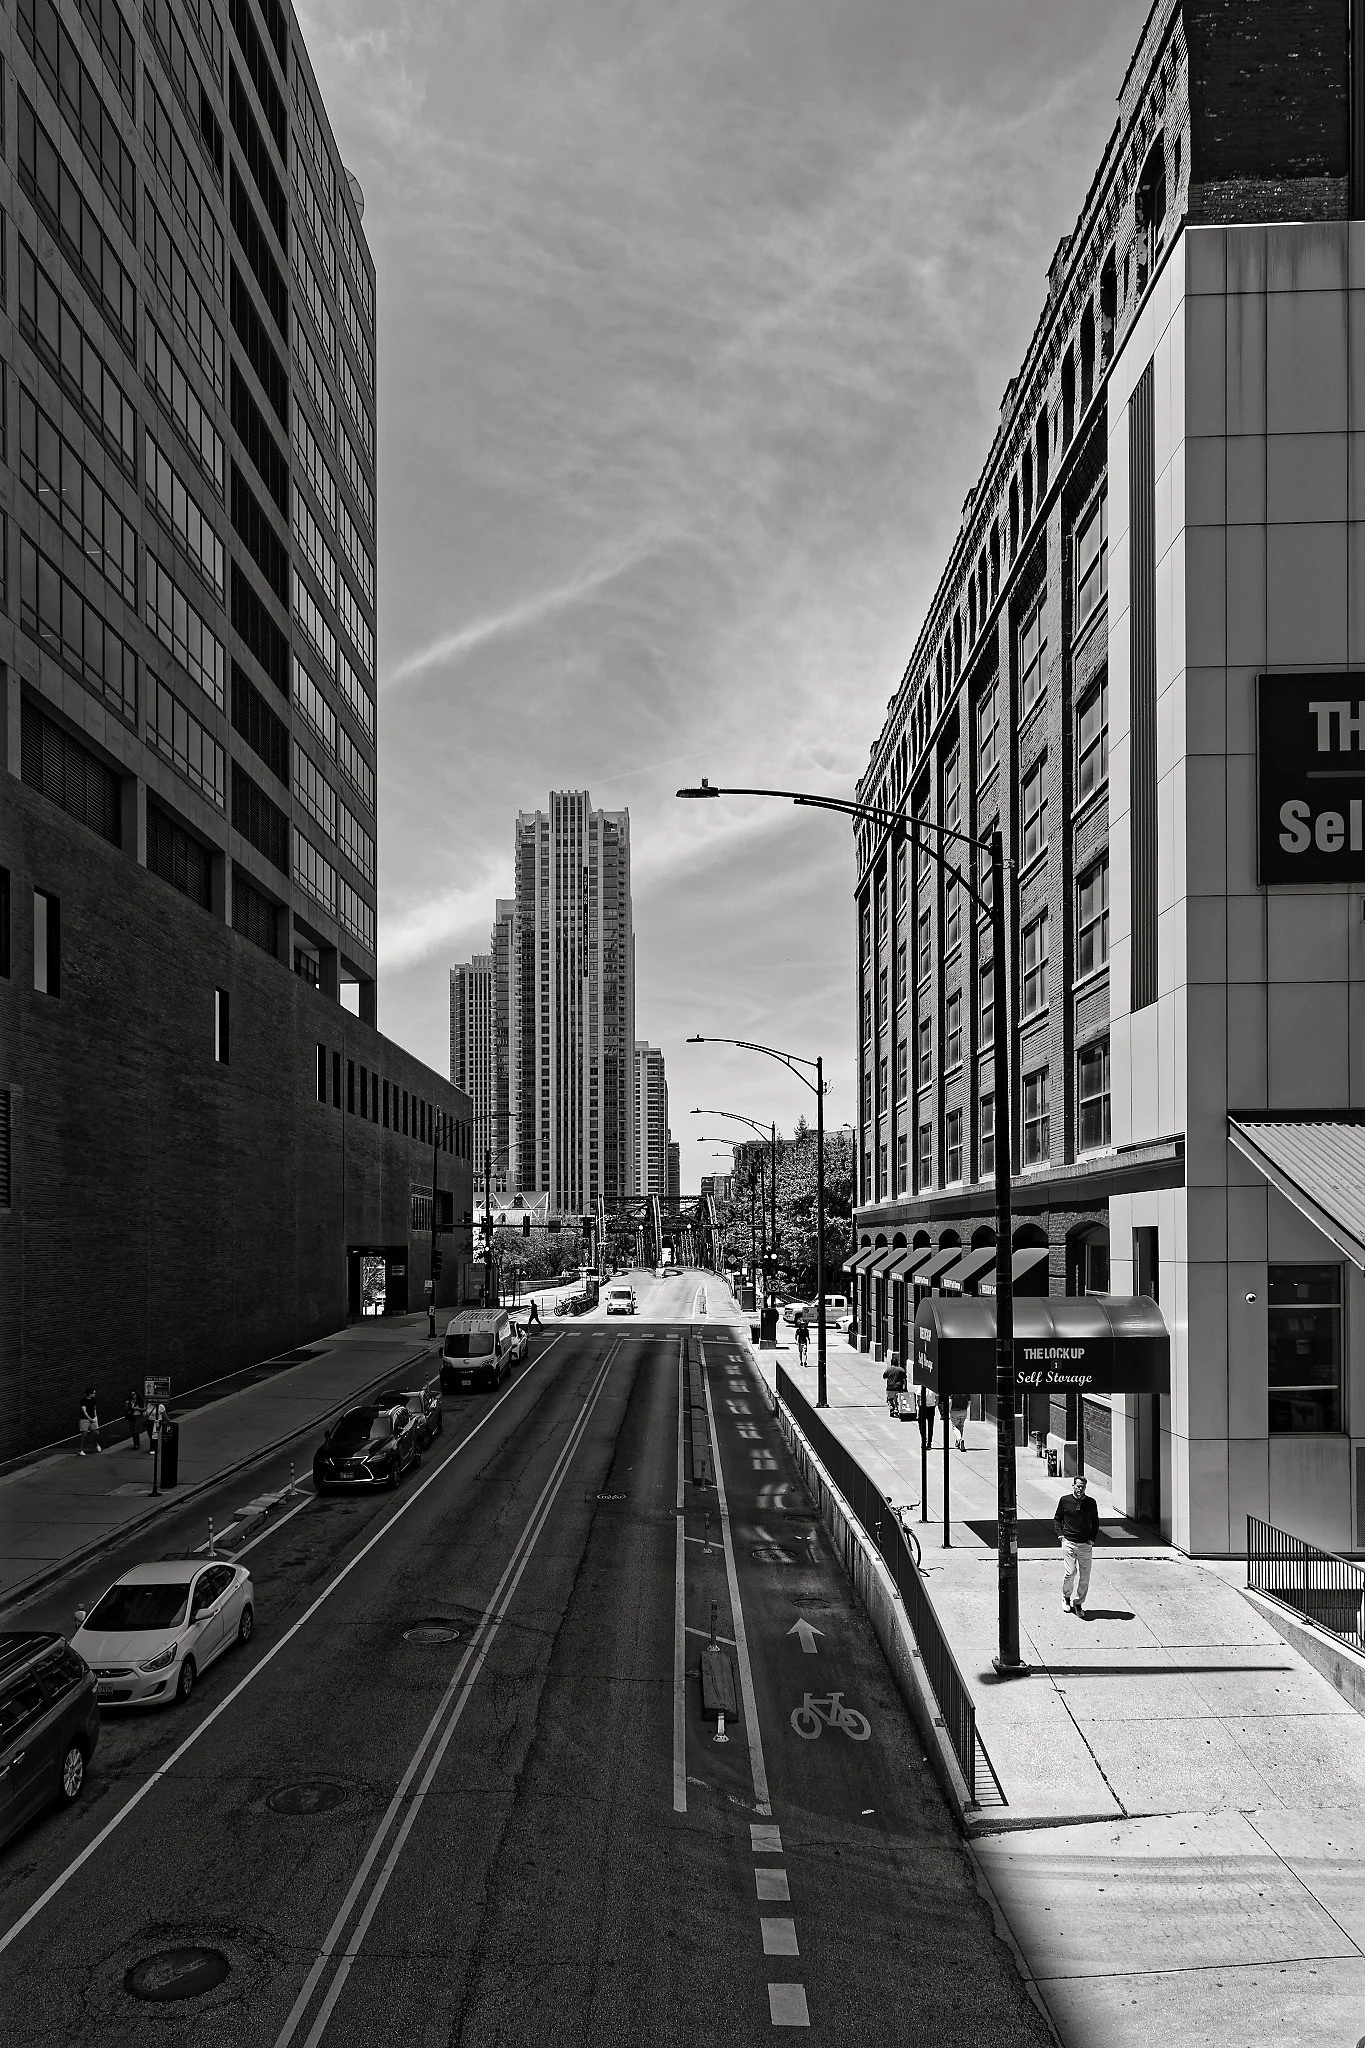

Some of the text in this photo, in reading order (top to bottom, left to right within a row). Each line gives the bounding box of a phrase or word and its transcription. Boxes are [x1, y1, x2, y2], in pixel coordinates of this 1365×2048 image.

[1279, 799, 1363, 853] Sel
[1016, 1370, 1093, 1387] Self Storage
